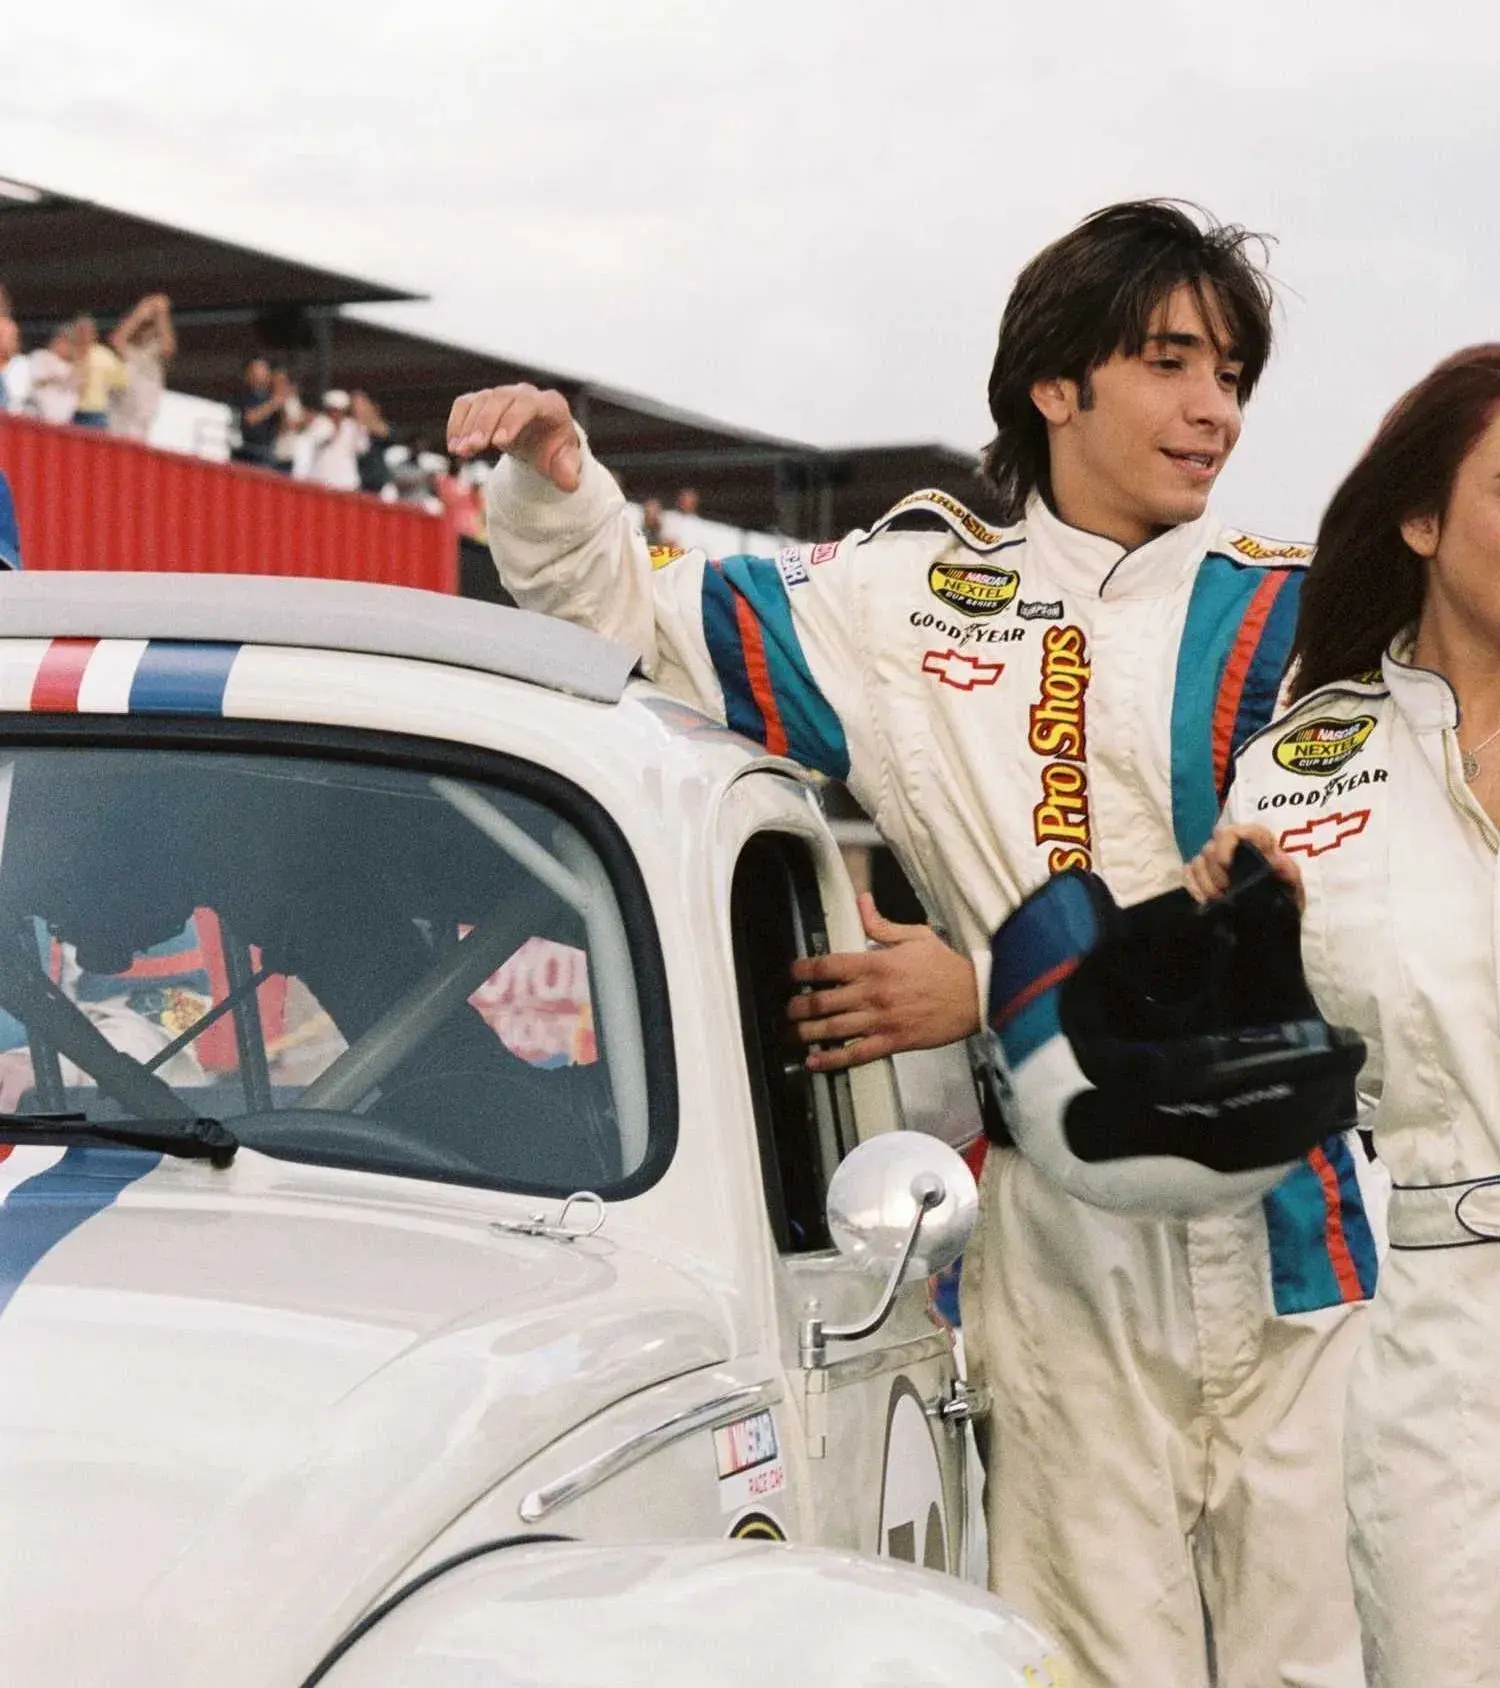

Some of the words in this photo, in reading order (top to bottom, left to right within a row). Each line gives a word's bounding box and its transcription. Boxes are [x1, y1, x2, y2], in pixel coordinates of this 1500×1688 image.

[943, 578, 1005, 599] NEXTEL
[1028, 624, 1092, 763] Shops
[1294, 737, 1361, 757] NEXTEL
[1032, 760, 1092, 851] Pro
